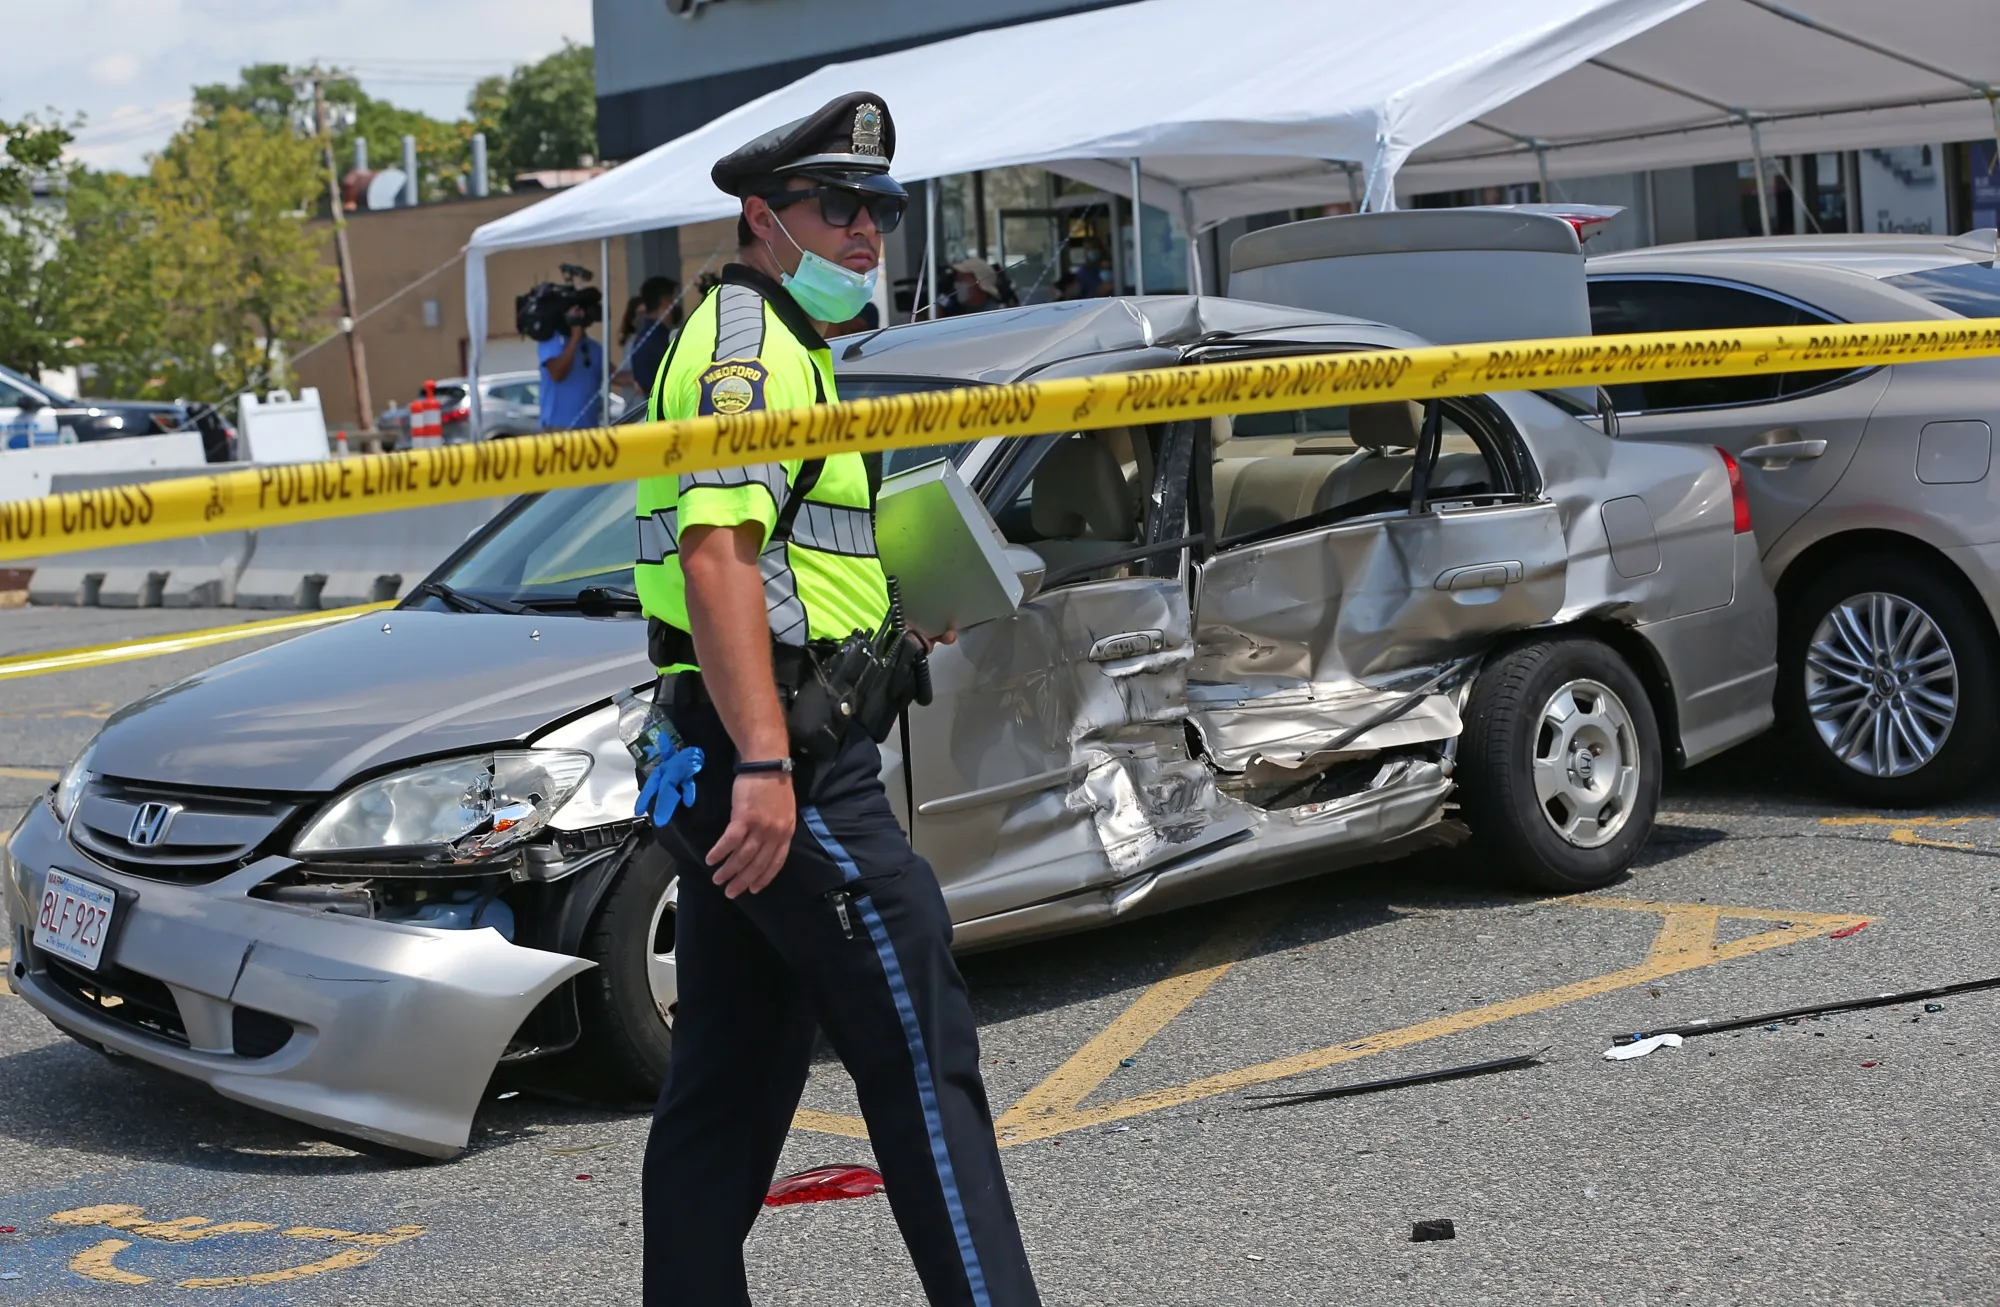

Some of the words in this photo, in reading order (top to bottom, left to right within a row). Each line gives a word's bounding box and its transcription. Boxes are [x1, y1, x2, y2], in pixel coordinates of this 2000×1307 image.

[704, 365, 762, 384] MEDFORD
[1116, 370, 1199, 412] POLICE
[1198, 366, 1252, 405] LINE
[1249, 363, 1290, 399] DO
[1284, 360, 1338, 396] NOT
[712, 410, 800, 457] POLICE
[806, 403, 860, 446] LINE
[865, 396, 901, 439] DO
[904, 389, 952, 435] NOT
[959, 383, 1041, 430] CROSS
[258, 459, 352, 511] POLICE
[362, 451, 418, 497] LINE
[429, 444, 464, 488] DO
[473, 436, 521, 484] NOT
[533, 427, 620, 477] CROSS
[59, 483, 154, 535] CROSS
[41, 891, 74, 935] 8LF
[72, 903, 107, 947] 923
